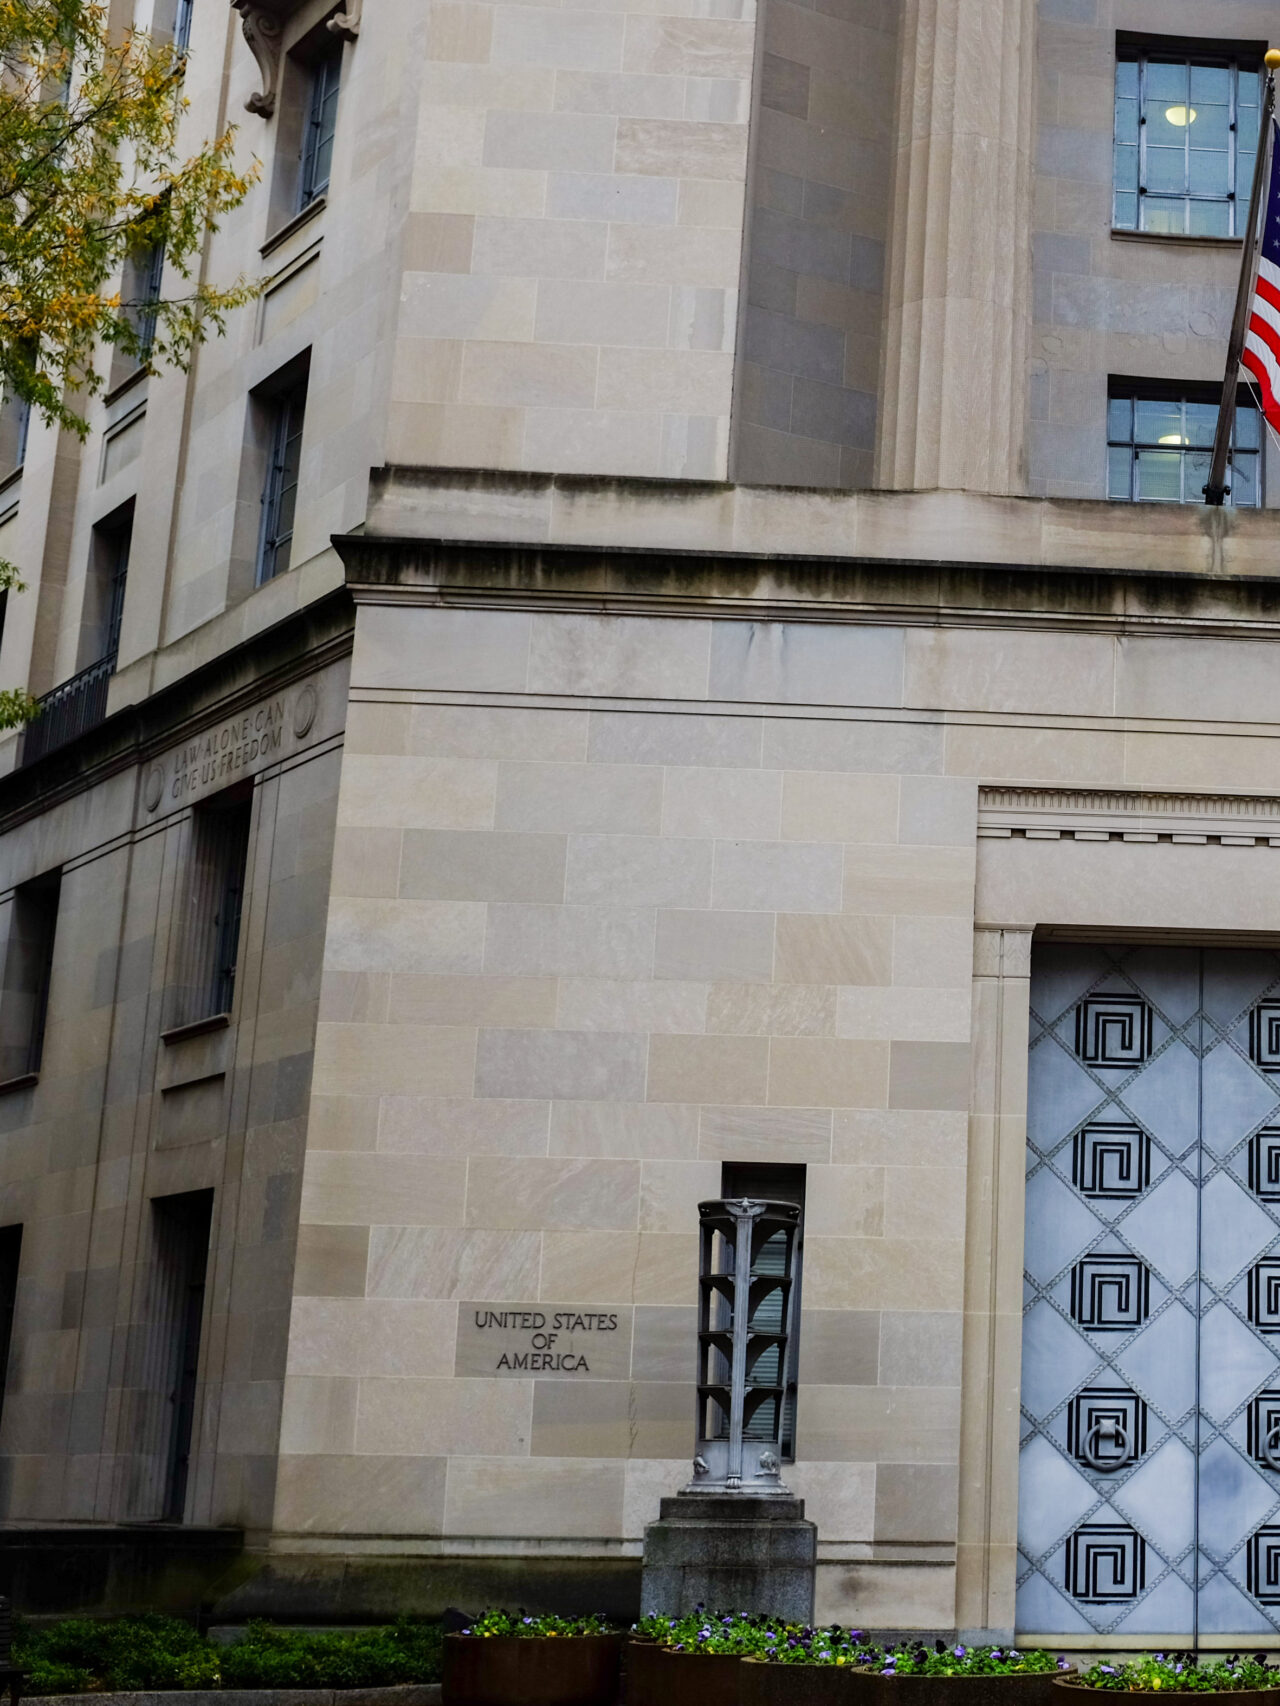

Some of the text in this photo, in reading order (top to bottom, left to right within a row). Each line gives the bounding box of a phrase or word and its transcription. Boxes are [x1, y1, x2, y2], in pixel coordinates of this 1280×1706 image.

[174, 699, 285, 774] LAW ALONE CAN
[171, 726, 282, 799] GIVE US FREEDOM
[475, 1311, 618, 1331] UNITED STATES
[531, 1333, 558, 1350] OF
[496, 1352, 590, 1371] AMERICA
